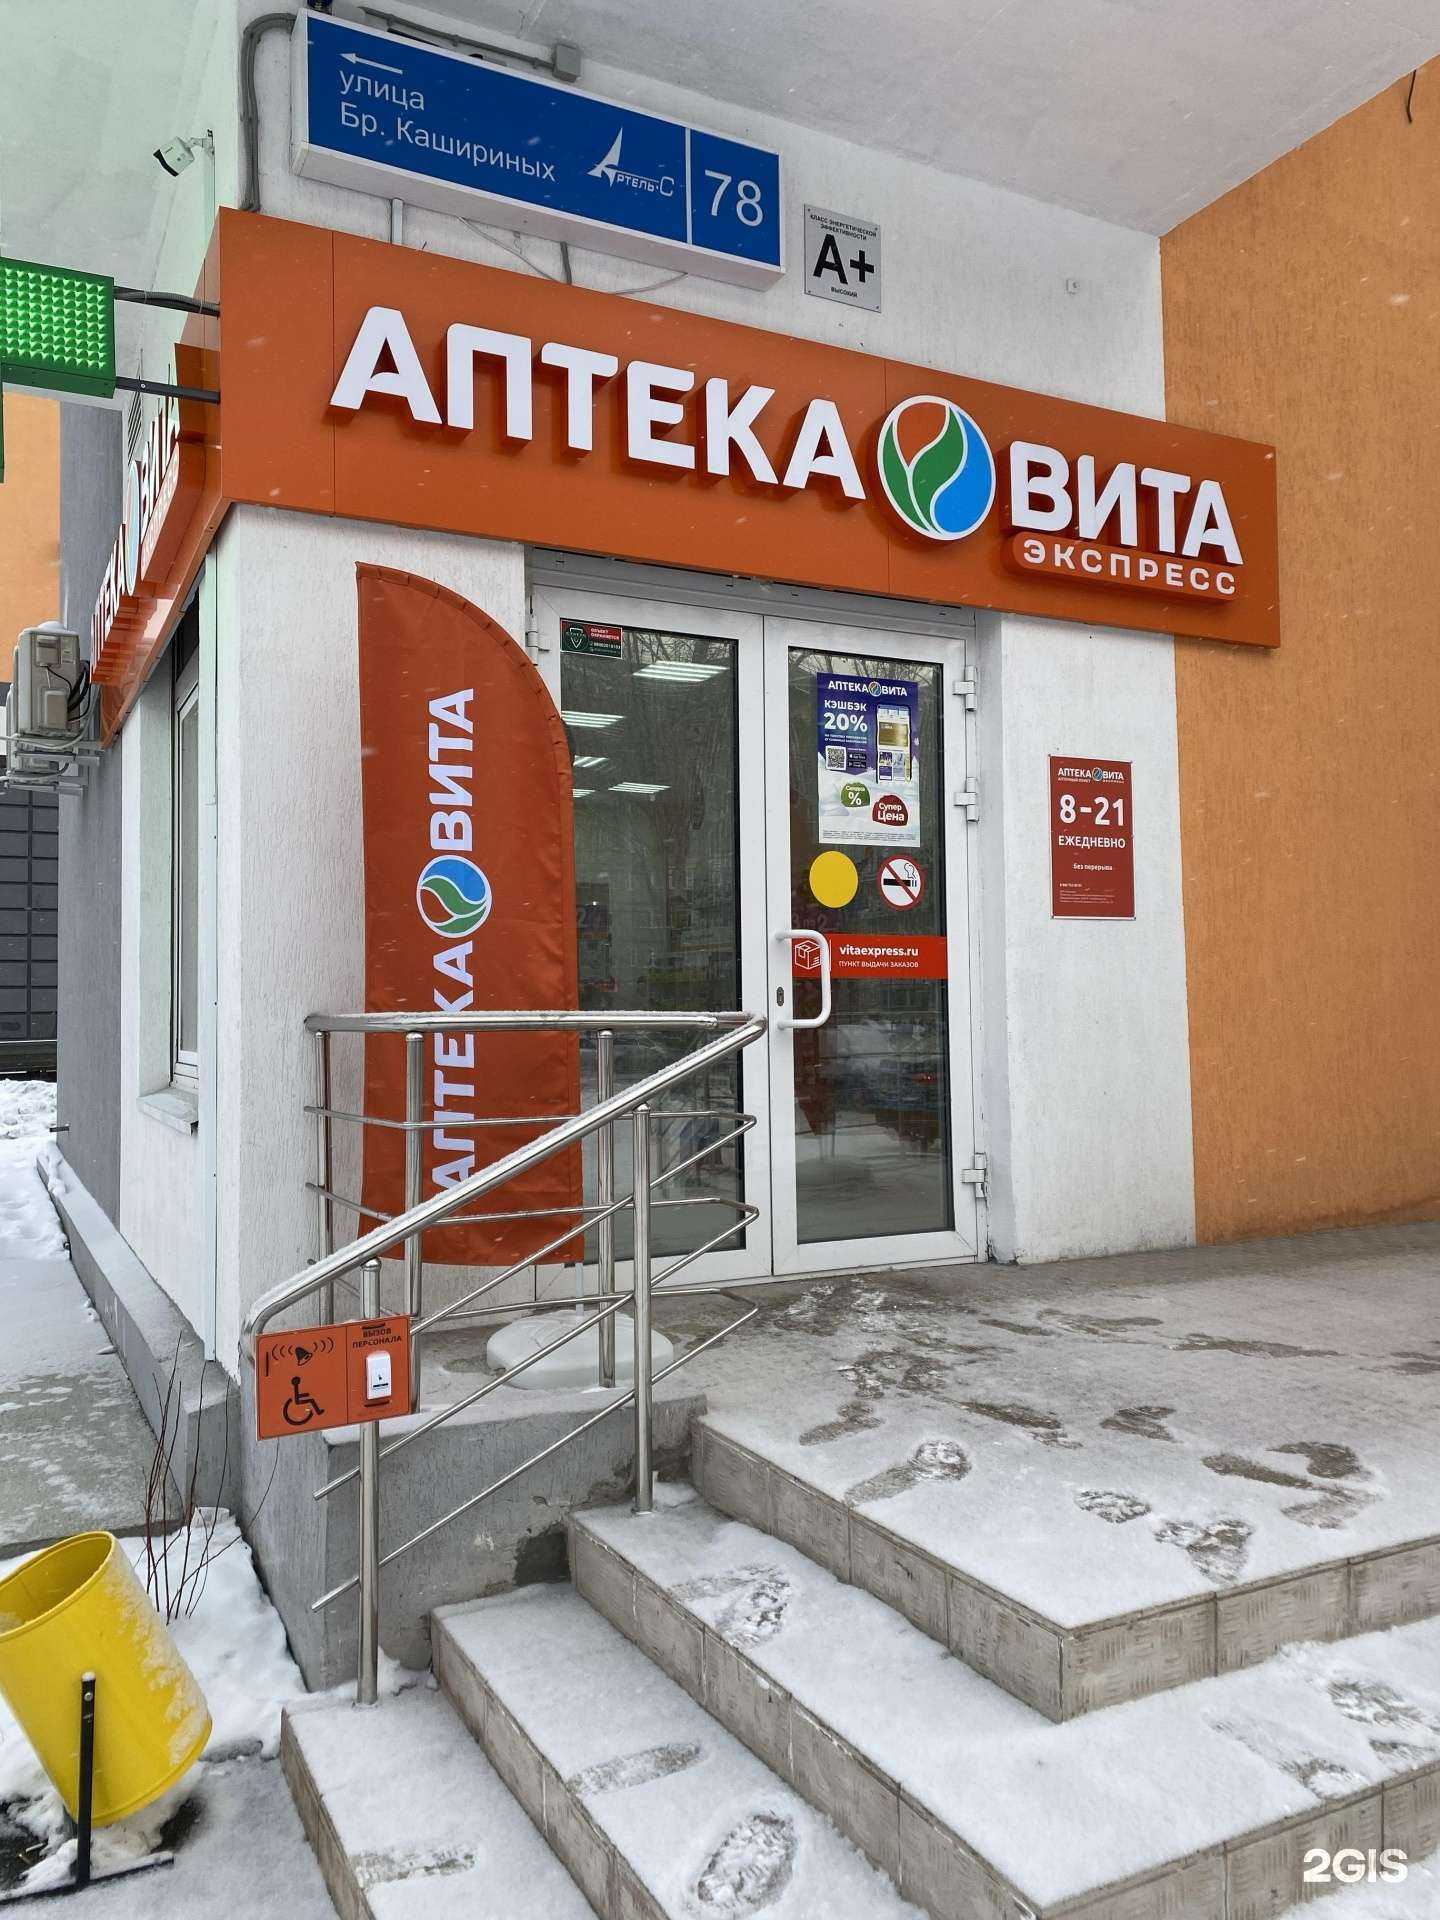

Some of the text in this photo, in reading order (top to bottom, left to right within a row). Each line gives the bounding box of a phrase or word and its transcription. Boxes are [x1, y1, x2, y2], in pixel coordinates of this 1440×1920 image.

[339, 70, 425, 111] улица
[341, 101, 556, 183] Бр. Кашириных
[705, 169, 764, 228] 78
[813, 233, 875, 285] A+
[330, 306, 1244, 565] АПТЕКА ВИТА
[1023, 539, 1236, 595] ЭКСПРЕСС
[828, 680, 908, 697] АПТЕКА ВИТА
[824, 699, 867, 712] КЭШБЭК
[823, 712, 868, 733] 20%
[428, 688, 474, 852] ВИТА
[1058, 768, 1125, 781] АПТЕКА ВИТА
[877, 811, 905, 822] Цена
[879, 803, 902, 814] Супер
[1058, 835, 1126, 850] ЕЖЕДНЕВНО
[839, 943, 919, 958] vitaexpress.ru
[839, 960, 861, 968] ПУНКТ
[362, 1327, 392, 1338] ВЫЗОВ
[353, 1335, 403, 1349] ПЕРСОНАЛА
